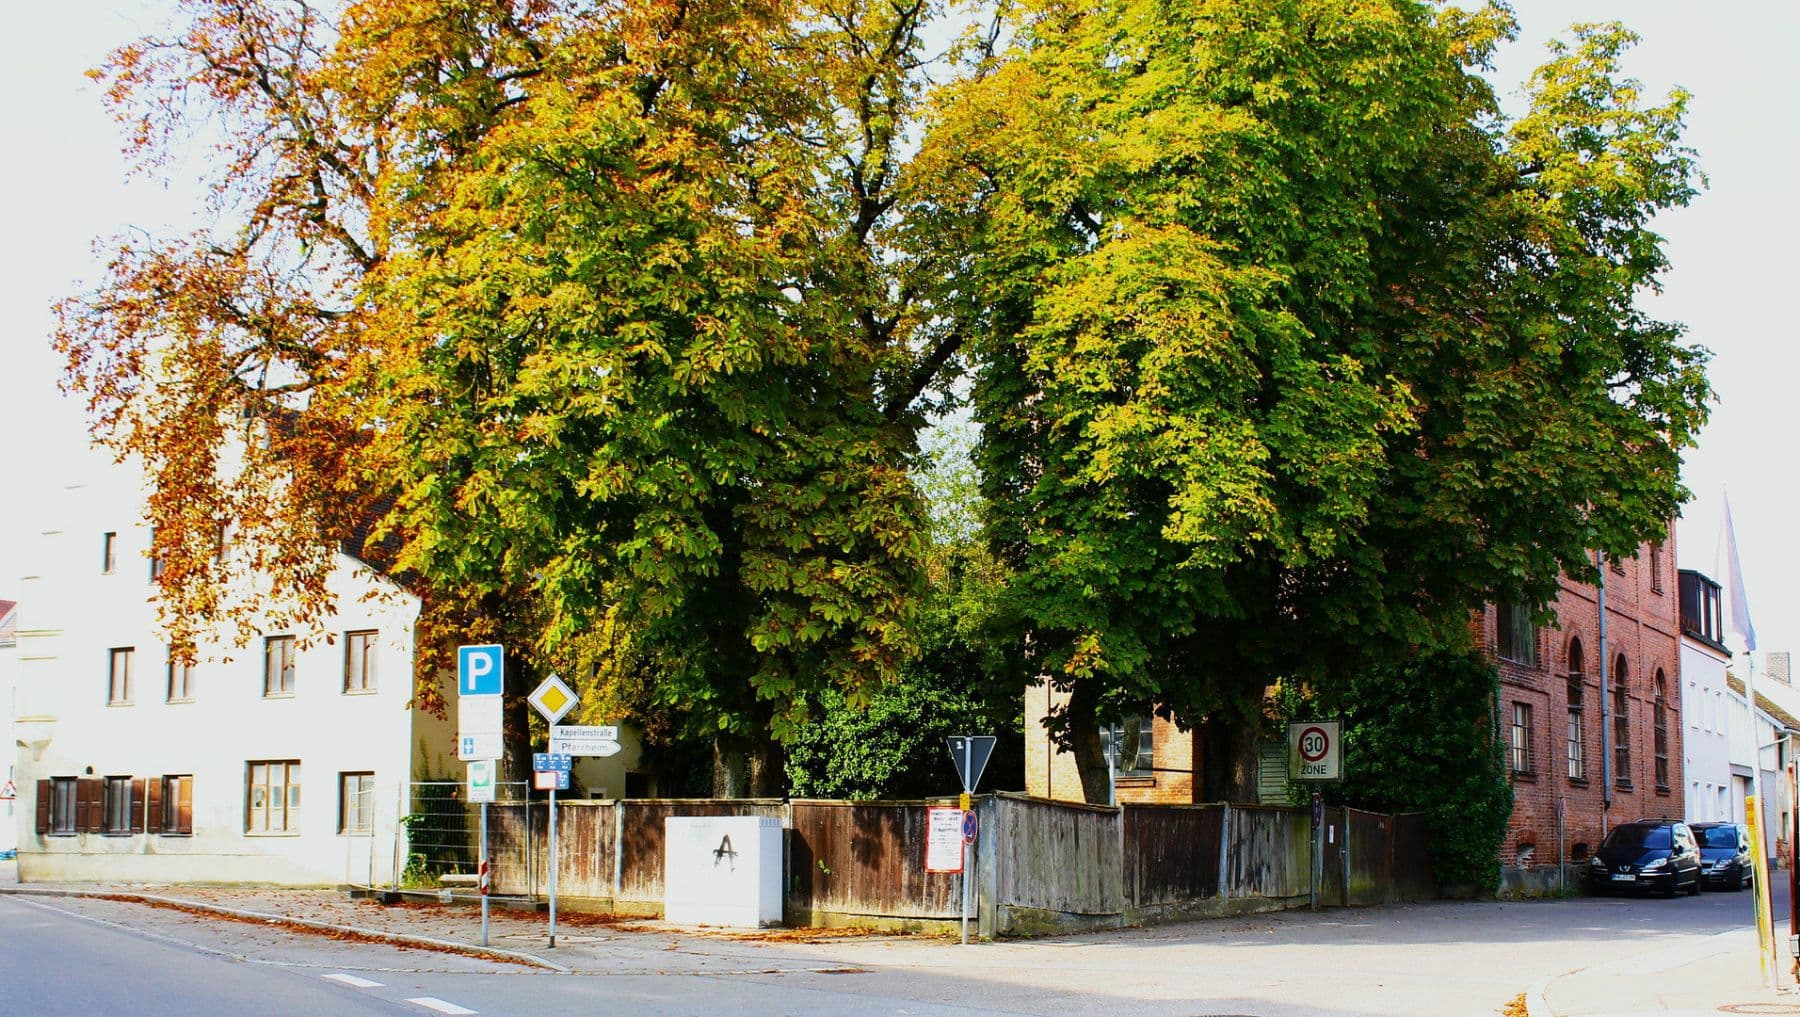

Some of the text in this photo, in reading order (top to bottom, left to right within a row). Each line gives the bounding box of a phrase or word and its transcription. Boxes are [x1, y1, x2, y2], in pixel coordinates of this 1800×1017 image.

[468, 652, 493, 690] P
[560, 727, 613, 737] Kapellenstraße
[1305, 737, 1323, 752] 30
[1301, 764, 1326, 775] ZONE
